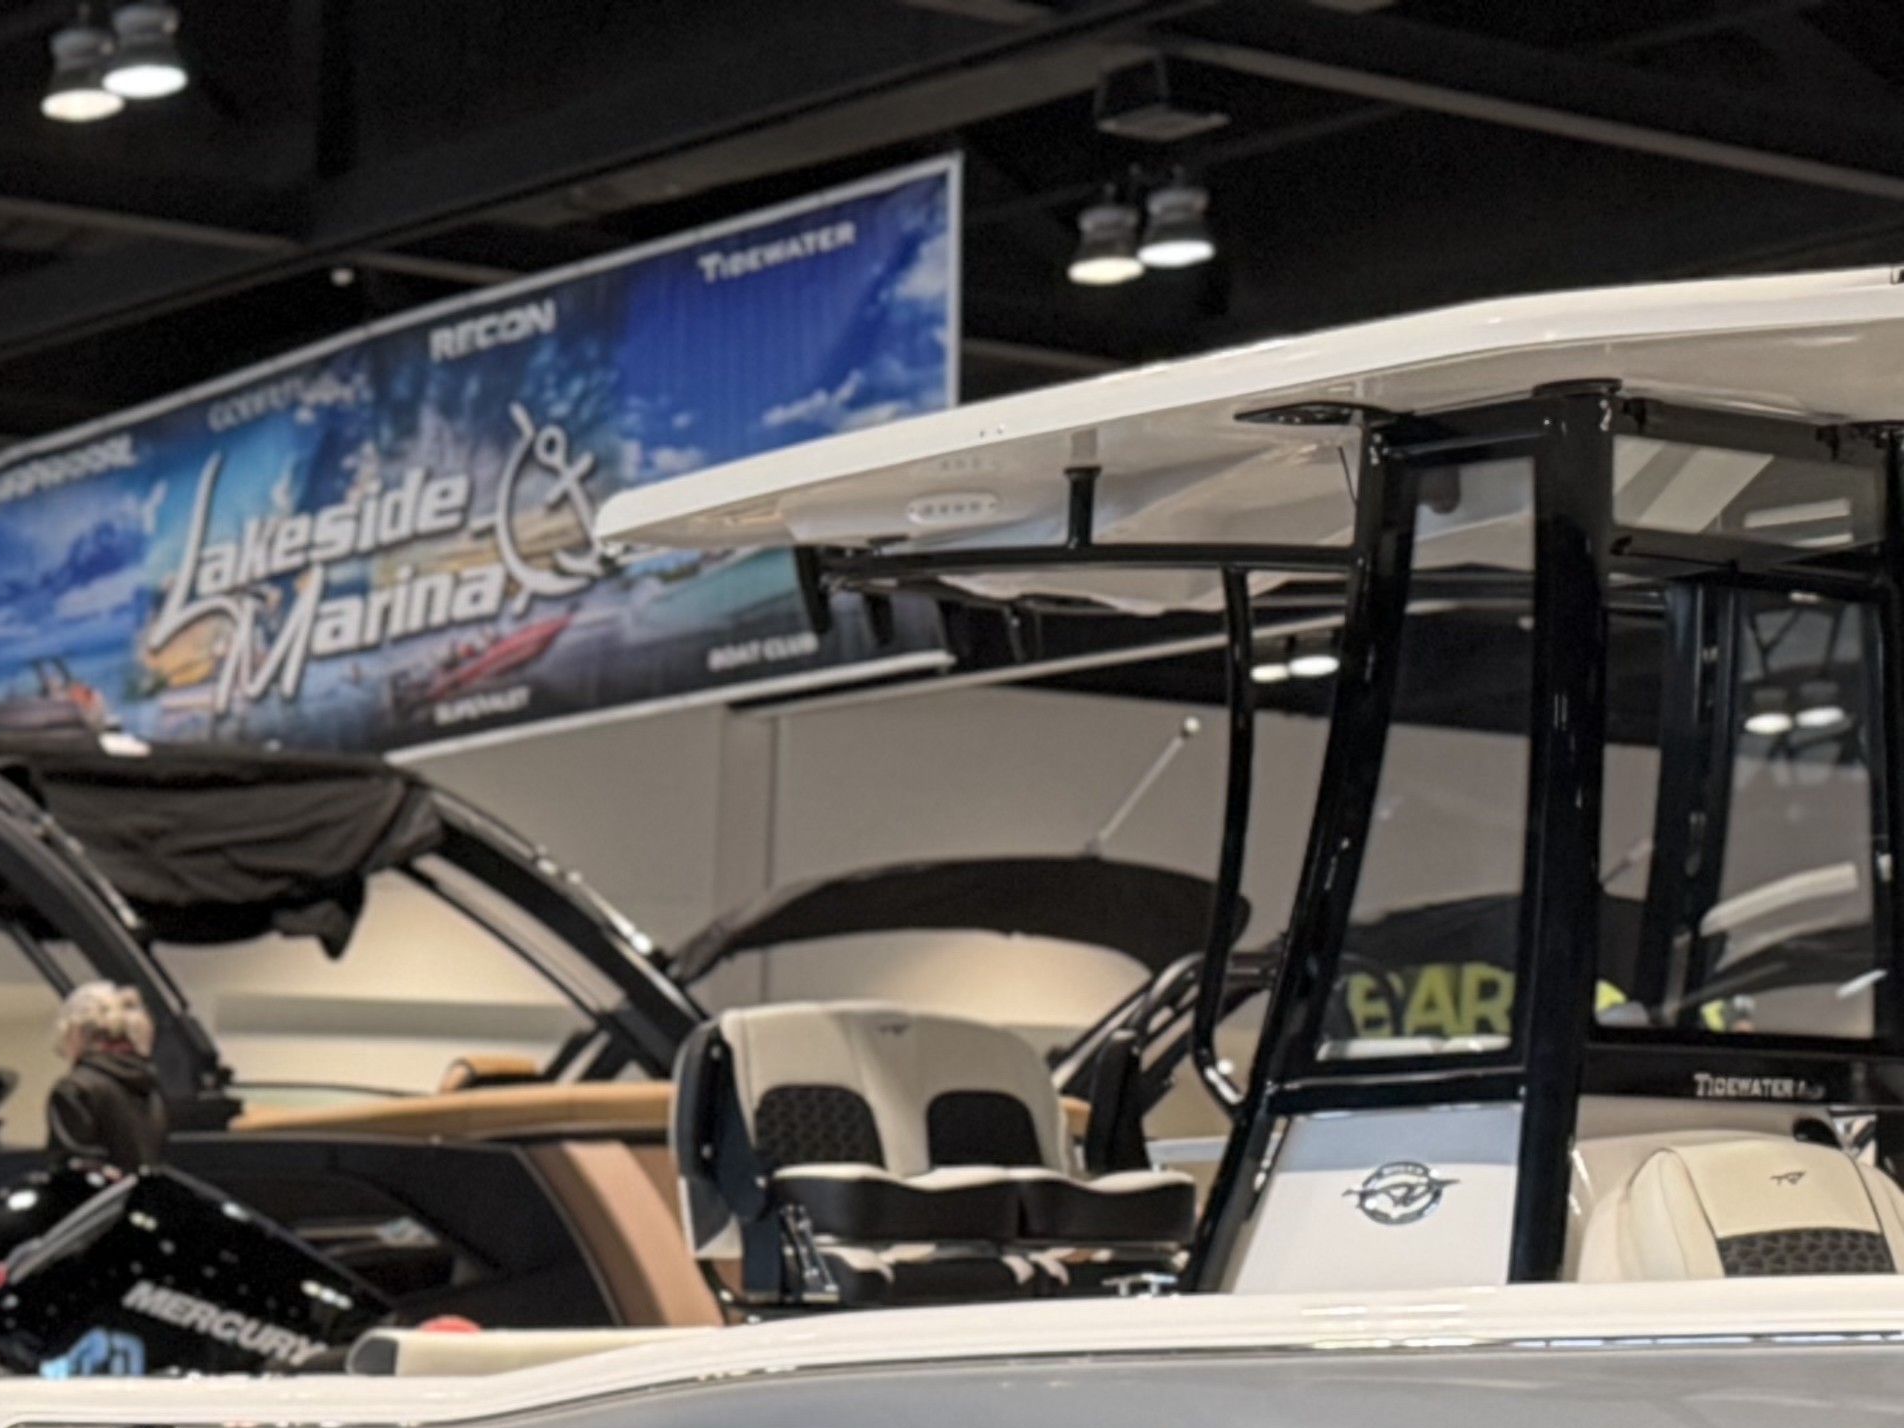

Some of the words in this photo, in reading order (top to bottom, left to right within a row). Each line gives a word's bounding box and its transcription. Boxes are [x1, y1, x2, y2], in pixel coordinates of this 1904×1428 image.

[428, 298, 557, 363] RECON
[147, 451, 470, 653] Lakeside
[214, 562, 506, 714] Marina
[121, 1280, 329, 1364] MERCURY
